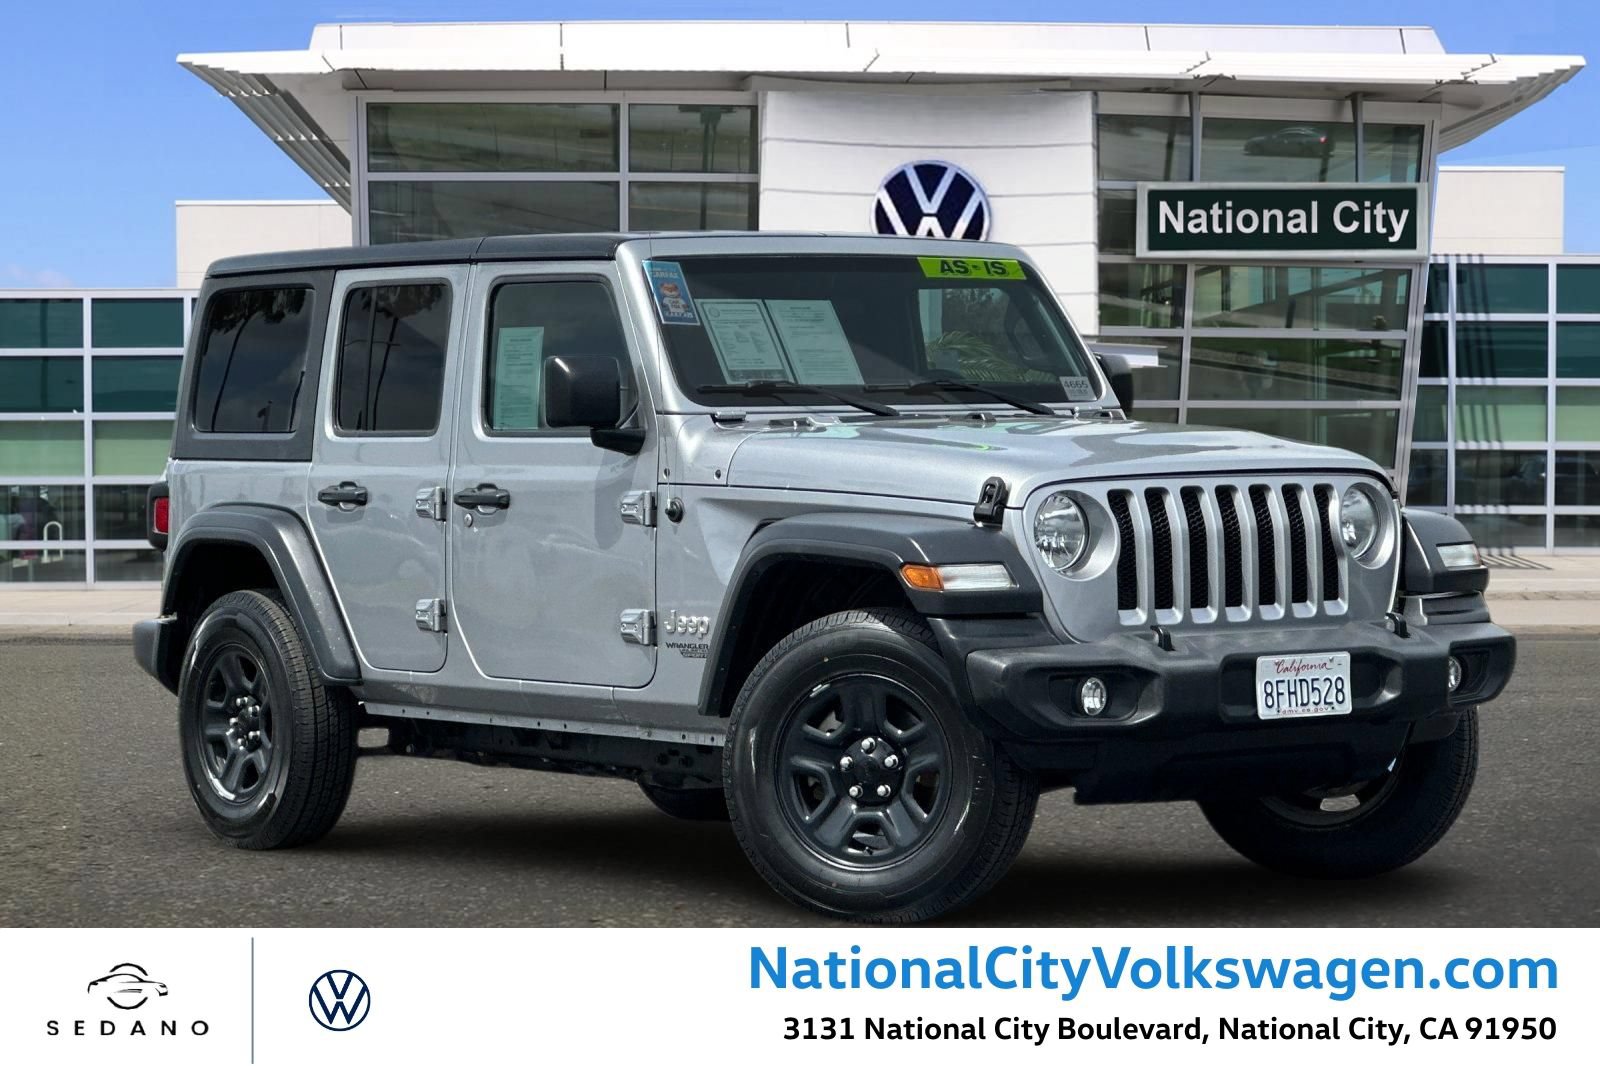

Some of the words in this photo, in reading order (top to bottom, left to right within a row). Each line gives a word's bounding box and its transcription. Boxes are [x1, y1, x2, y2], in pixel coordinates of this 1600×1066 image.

[1159, 200, 1318, 234] National
[1332, 200, 1410, 243] City
[663, 609, 709, 639] Jeep
[665, 642, 709, 650] WRANGLER
[1275, 658, 1334, 677] California
[1263, 676, 1346, 709] 8FHD528
